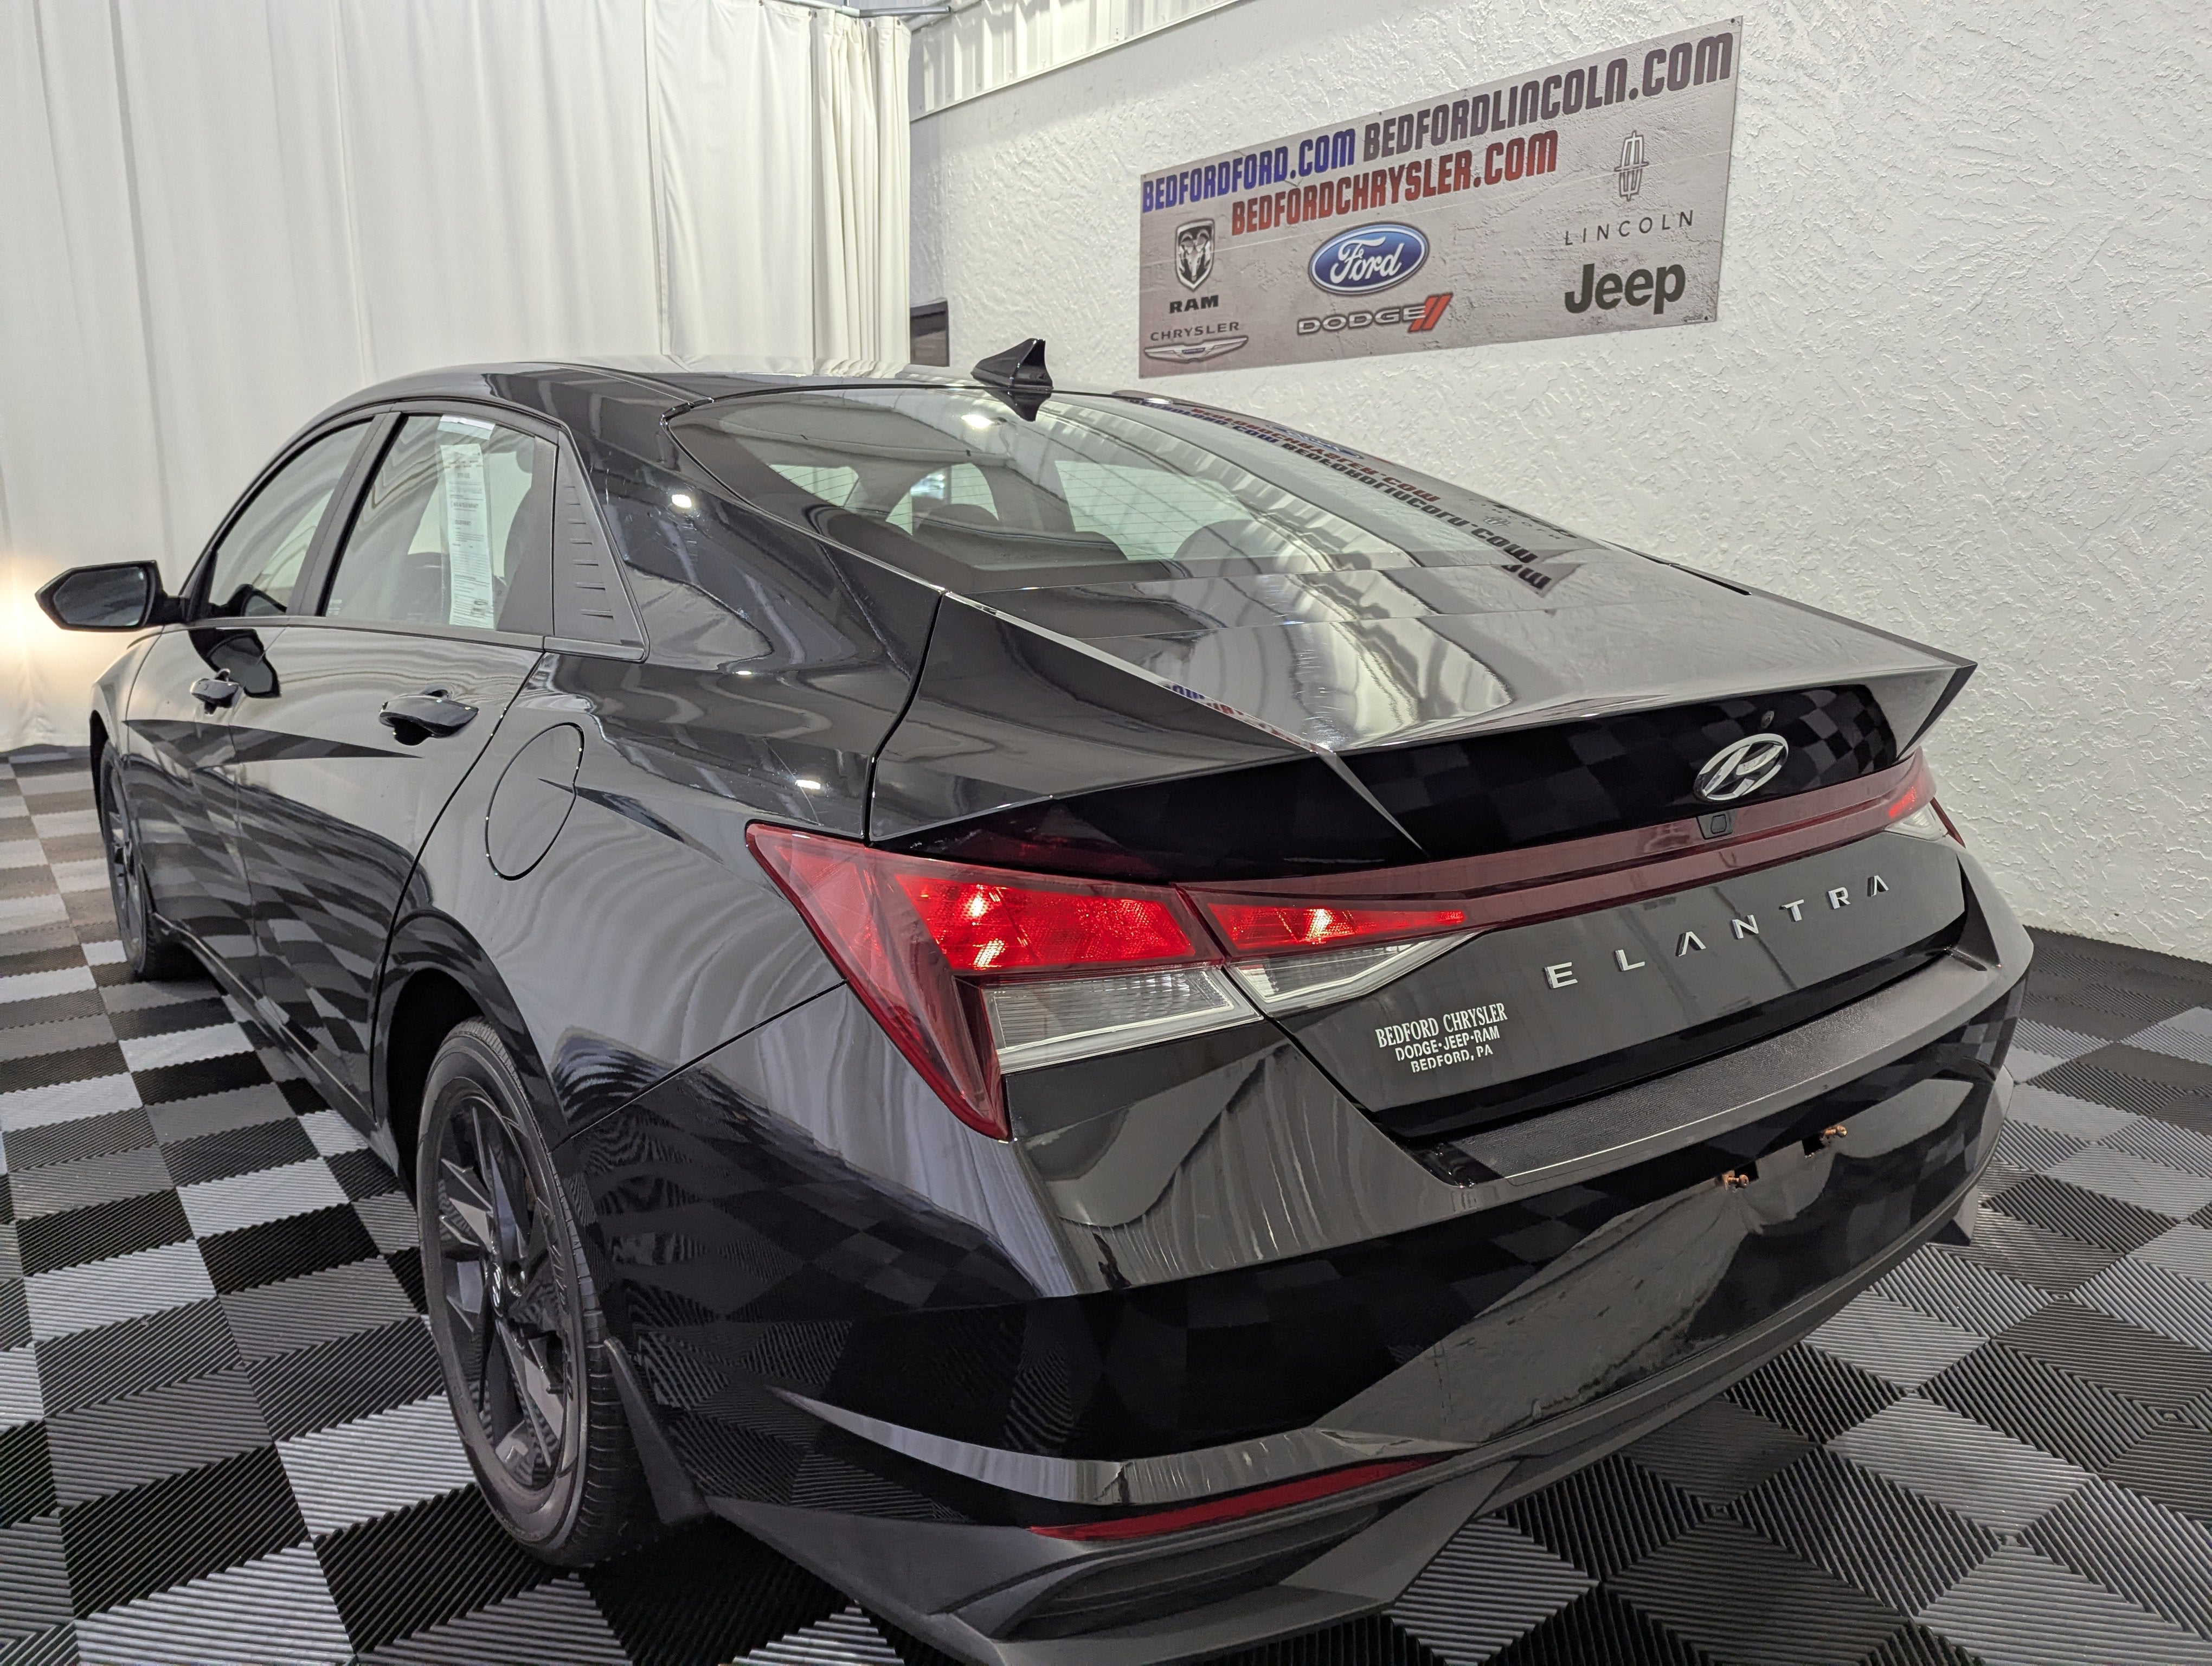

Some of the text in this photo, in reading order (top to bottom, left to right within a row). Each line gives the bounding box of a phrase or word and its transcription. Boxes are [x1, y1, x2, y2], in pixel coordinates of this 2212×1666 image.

[1142, 33, 1733, 213] BEDFORDFORD.COM BEDFORDLINCOLN.COM
[1232, 130, 1558, 235] BEDFORDCHRYSLER.COM
[1565, 210, 1693, 245] LINCOLN
[1330, 236, 1404, 283] Ford
[1169, 294, 1219, 313] RAM
[1565, 263, 1686, 315] Jeep
[1150, 322, 1239, 341] CHRYSLER
[1297, 303, 1426, 335] DODGE
[1545, 875, 1889, 989] ELANTRA
[1375, 1003, 1508, 1048] BEDFORD CHRYSLER
[1411, 1045, 1493, 1073] BEDFORD, PA
